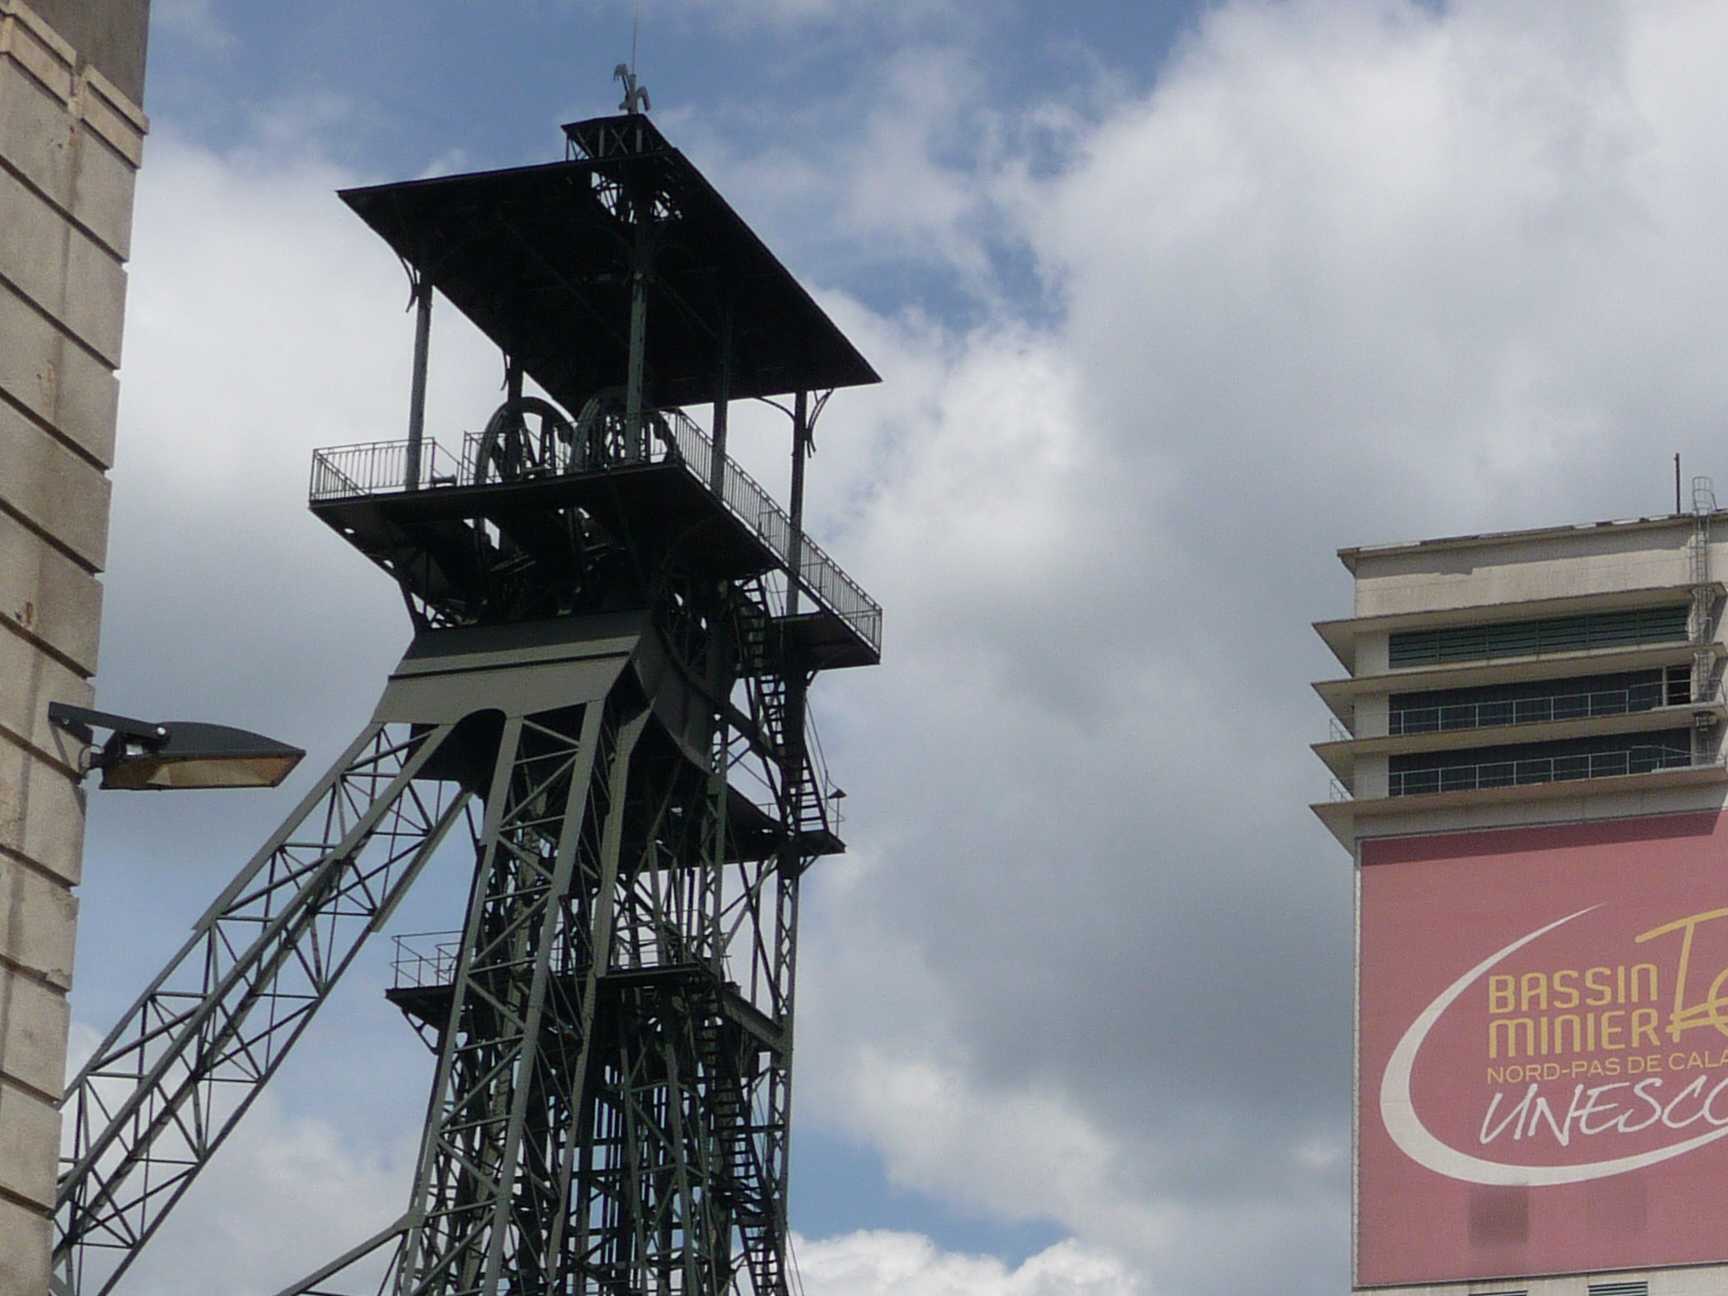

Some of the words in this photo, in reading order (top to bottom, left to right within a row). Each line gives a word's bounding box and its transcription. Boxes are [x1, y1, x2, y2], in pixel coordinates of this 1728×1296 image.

[1488, 963, 1659, 1014] BASSIN
[1488, 1008, 1661, 1059] MINIER
[1487, 1058, 1621, 1085] NORD-PAS
[1627, 1054, 1662, 1075] DE
